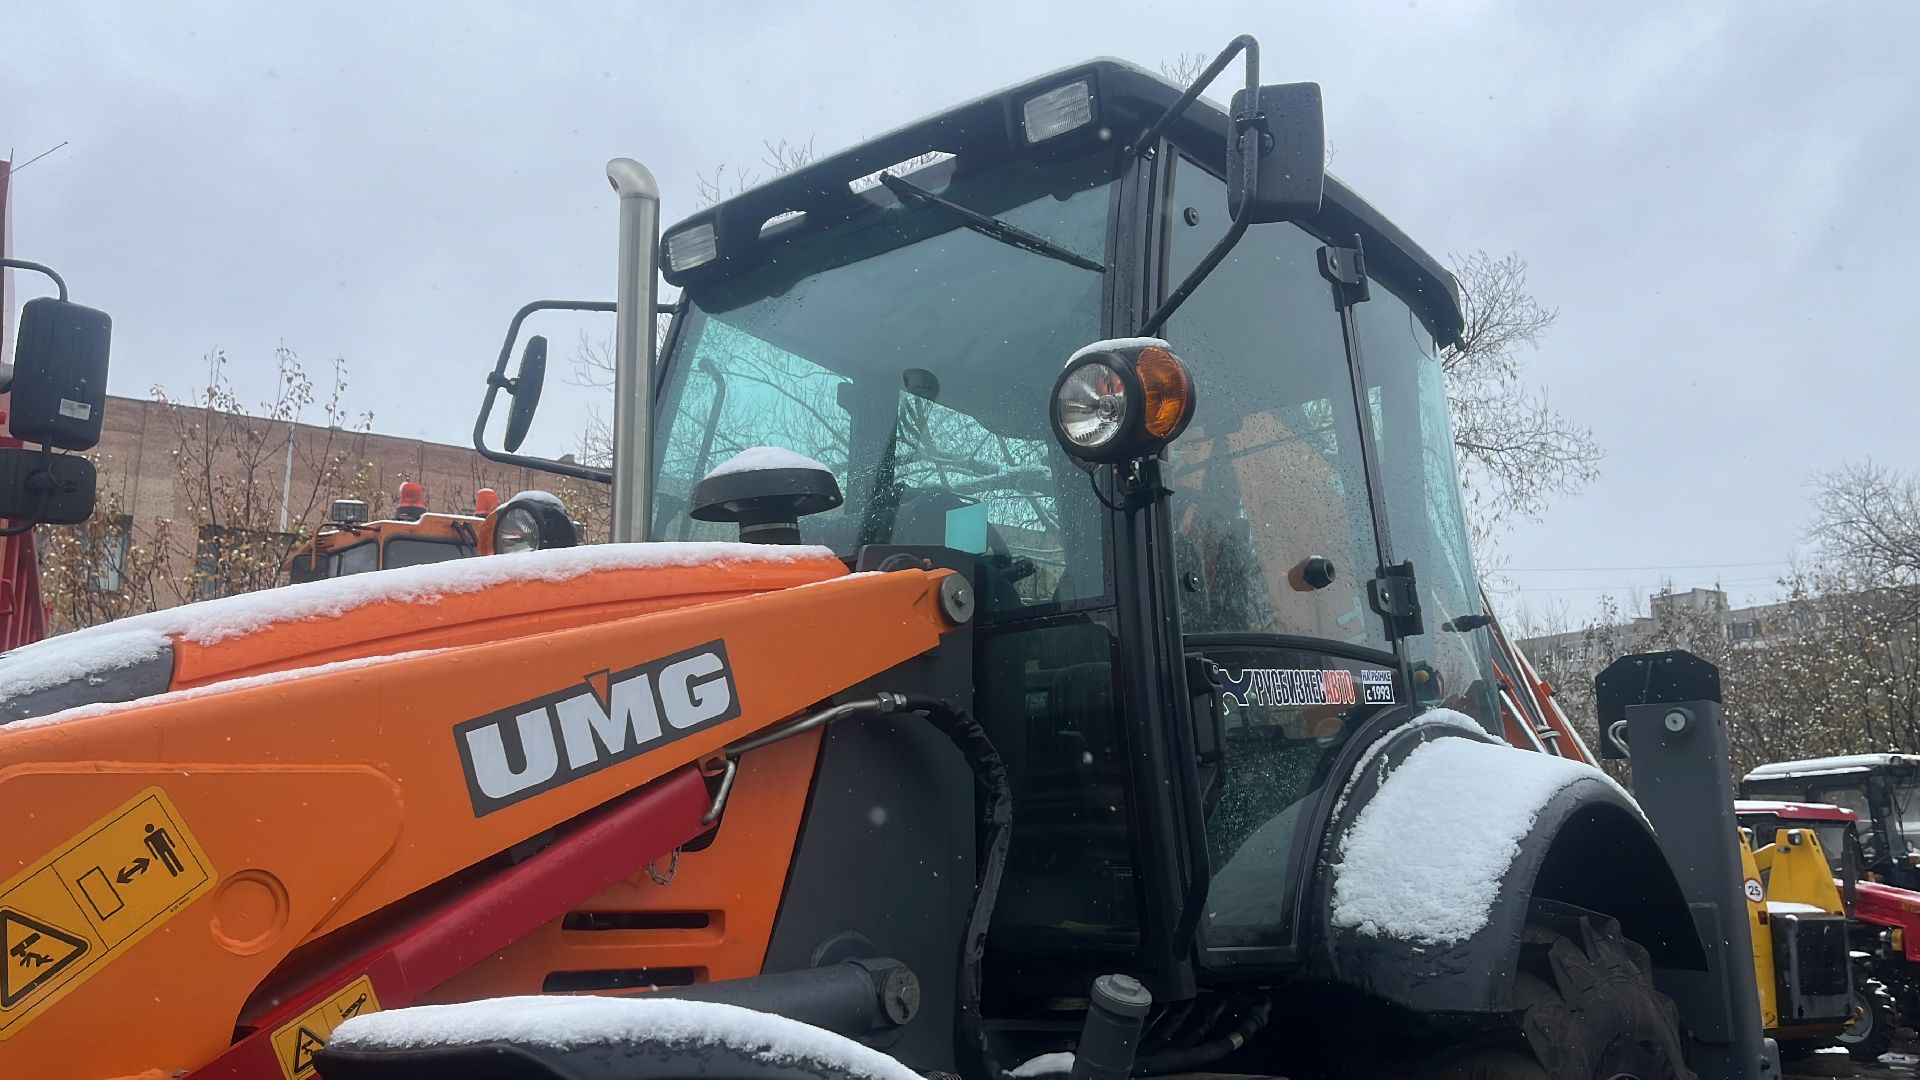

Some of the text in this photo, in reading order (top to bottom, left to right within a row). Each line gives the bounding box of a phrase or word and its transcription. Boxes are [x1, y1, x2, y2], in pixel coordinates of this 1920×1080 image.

[1252, 669, 1355, 706] РУСБИЗНЕСАВТО
[1372, 685, 1391, 700] 1993
[465, 652, 730, 799] UMG
[1748, 885, 1761, 896] 25
